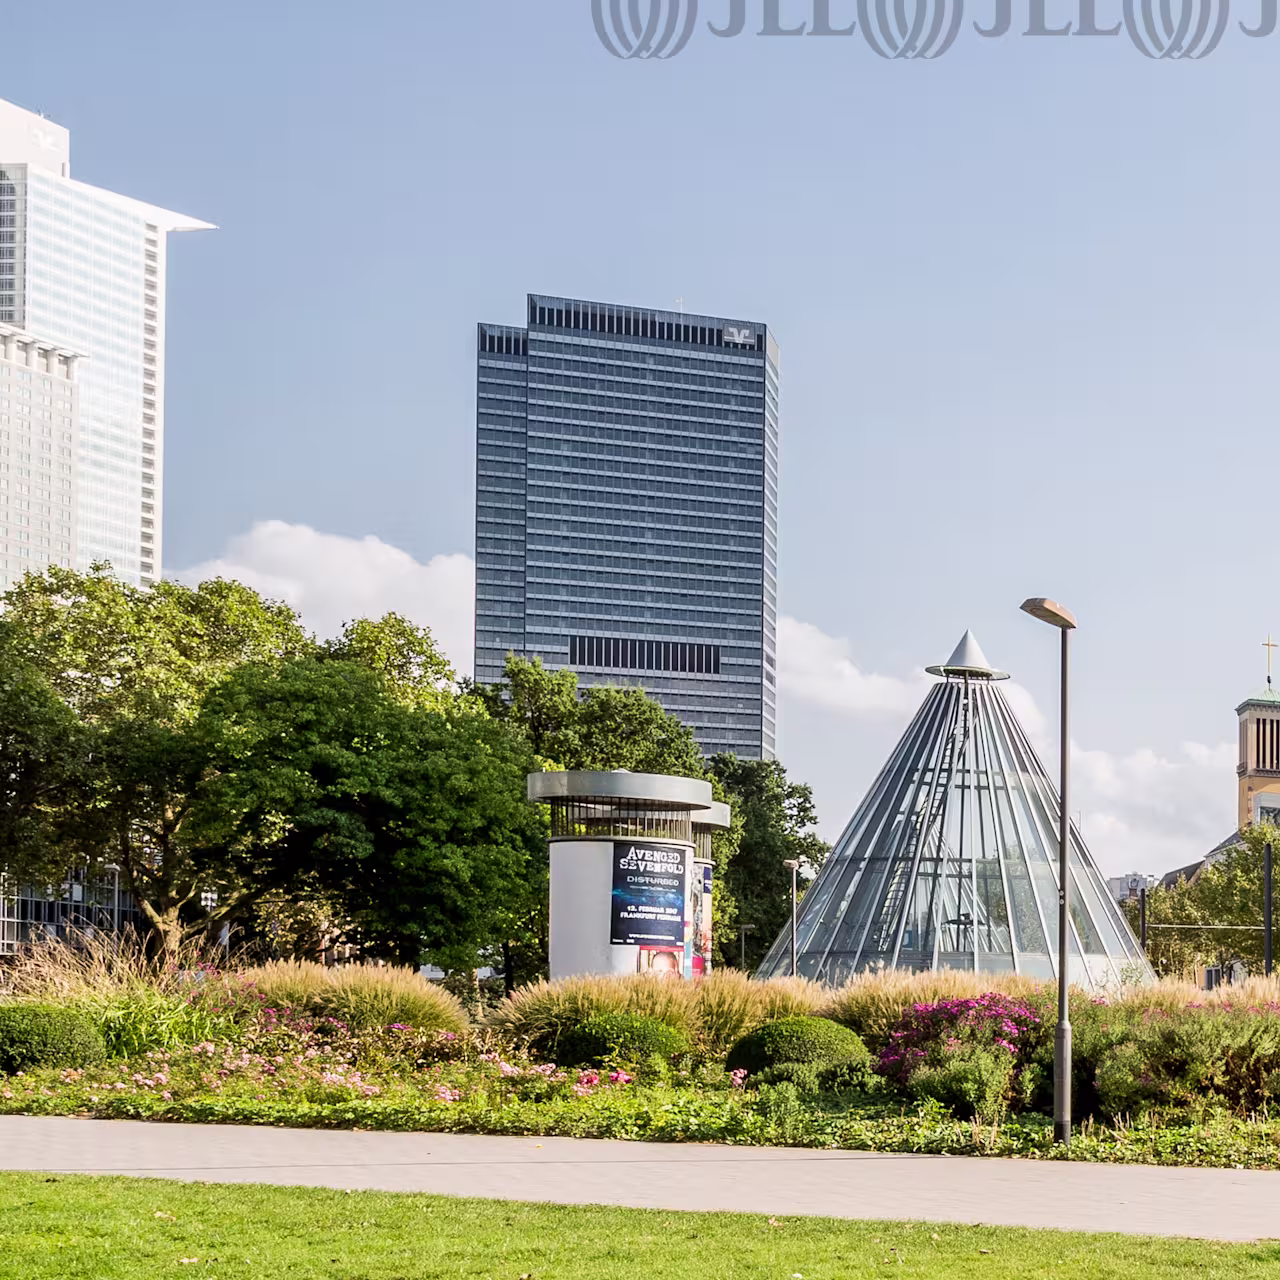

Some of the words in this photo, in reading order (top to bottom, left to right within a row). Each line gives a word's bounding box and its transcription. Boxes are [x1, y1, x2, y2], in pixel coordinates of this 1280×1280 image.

[626, 846, 681, 864] AVENGED
[619, 858, 684, 875] SEVENFOLD
[626, 876, 680, 887] DISTURBED
